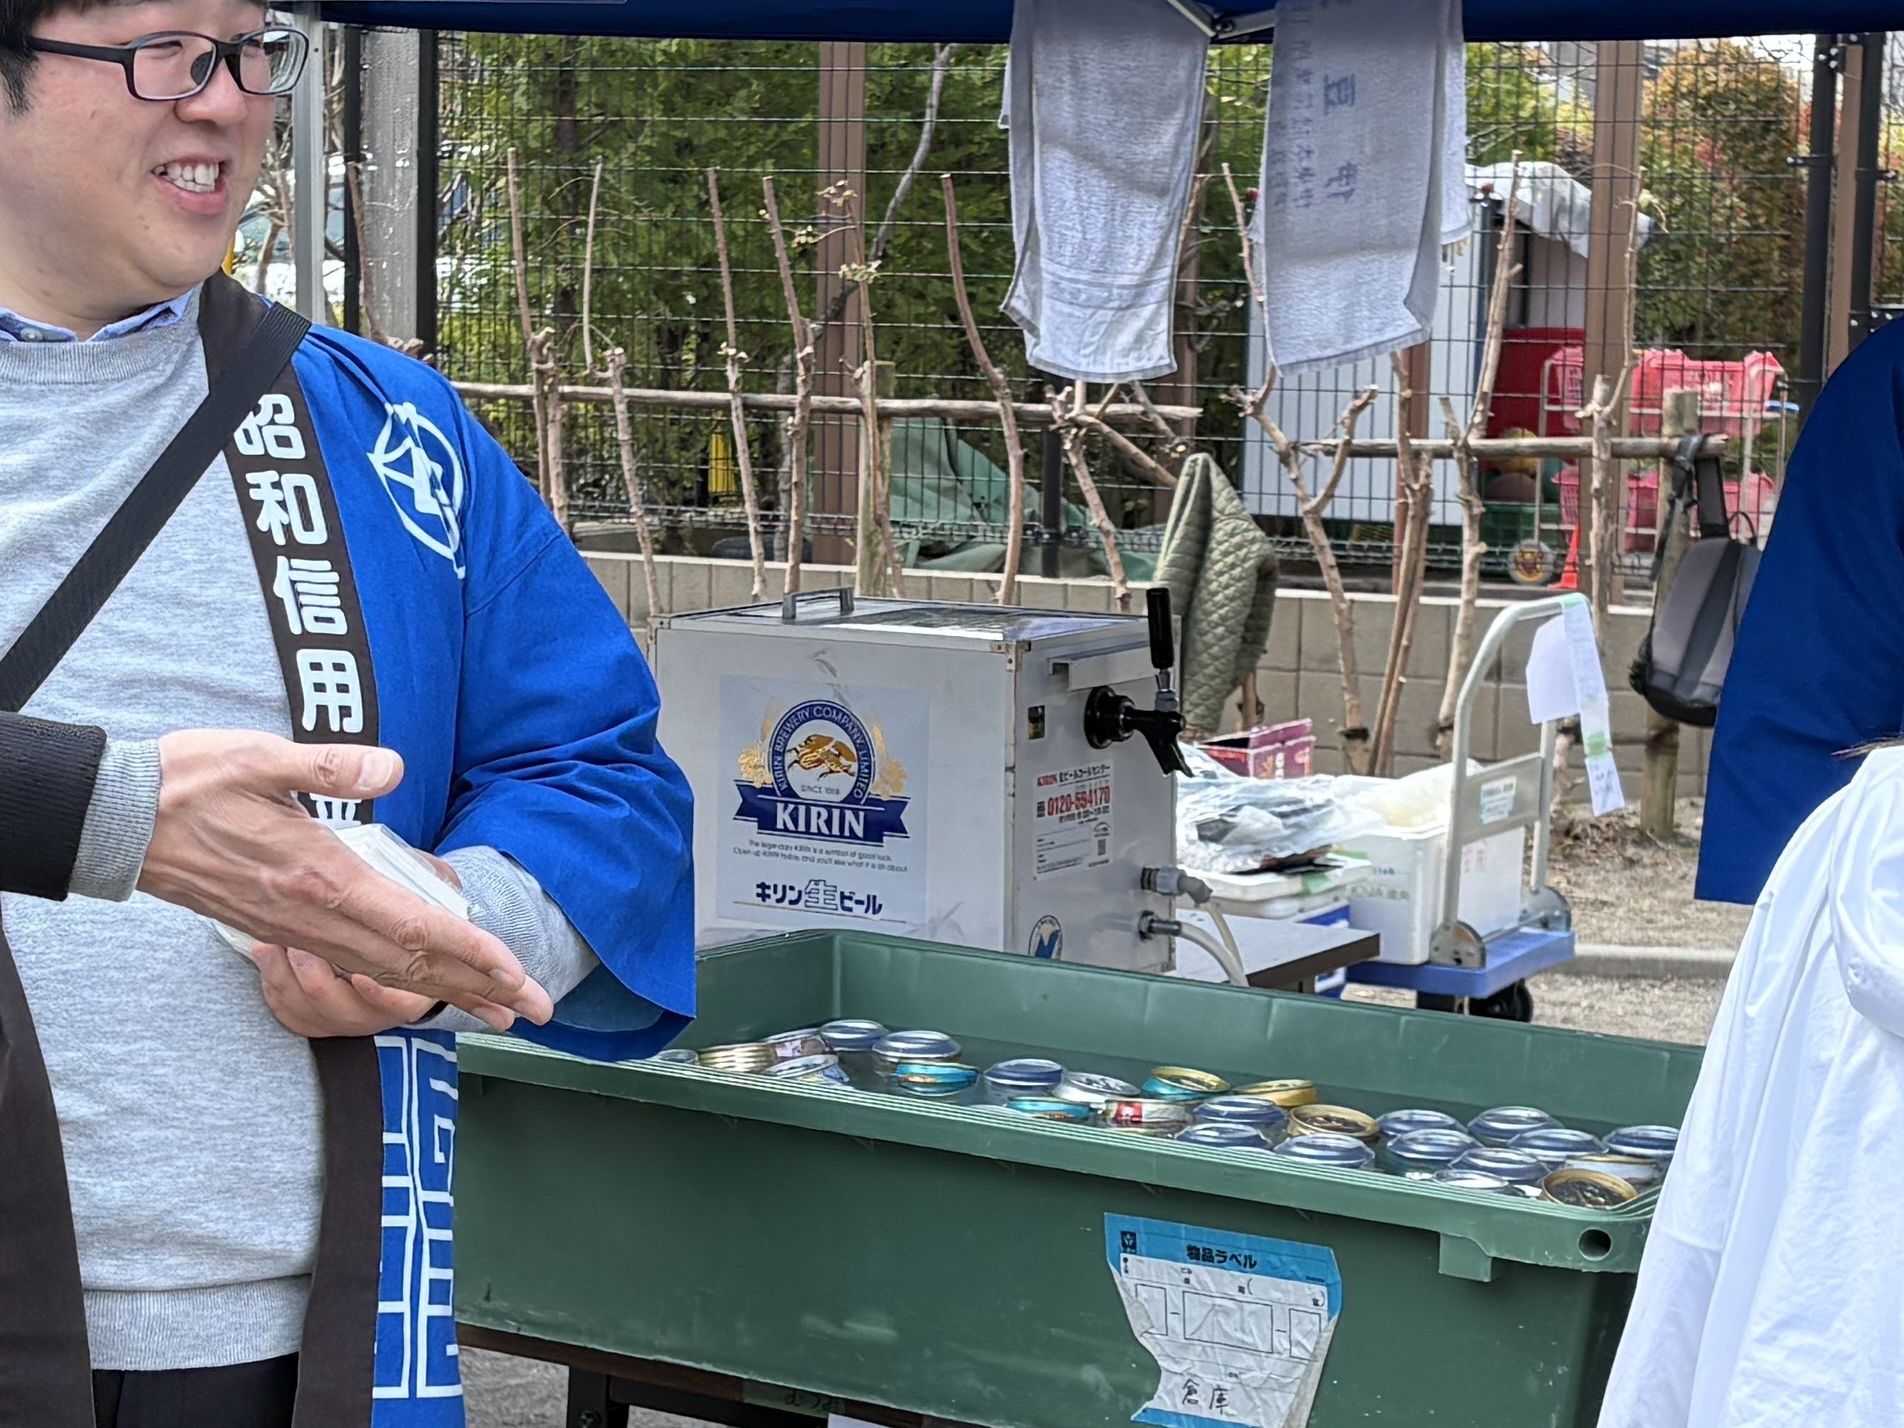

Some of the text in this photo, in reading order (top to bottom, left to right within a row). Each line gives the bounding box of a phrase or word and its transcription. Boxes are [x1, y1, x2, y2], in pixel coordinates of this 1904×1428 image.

[776, 803, 865, 838] KIRIN
[756, 879, 883, 915] キリン生ビール
[1186, 1244, 1258, 1270] 物品ラベル
[1182, 1378, 1232, 1415] 倉庫
